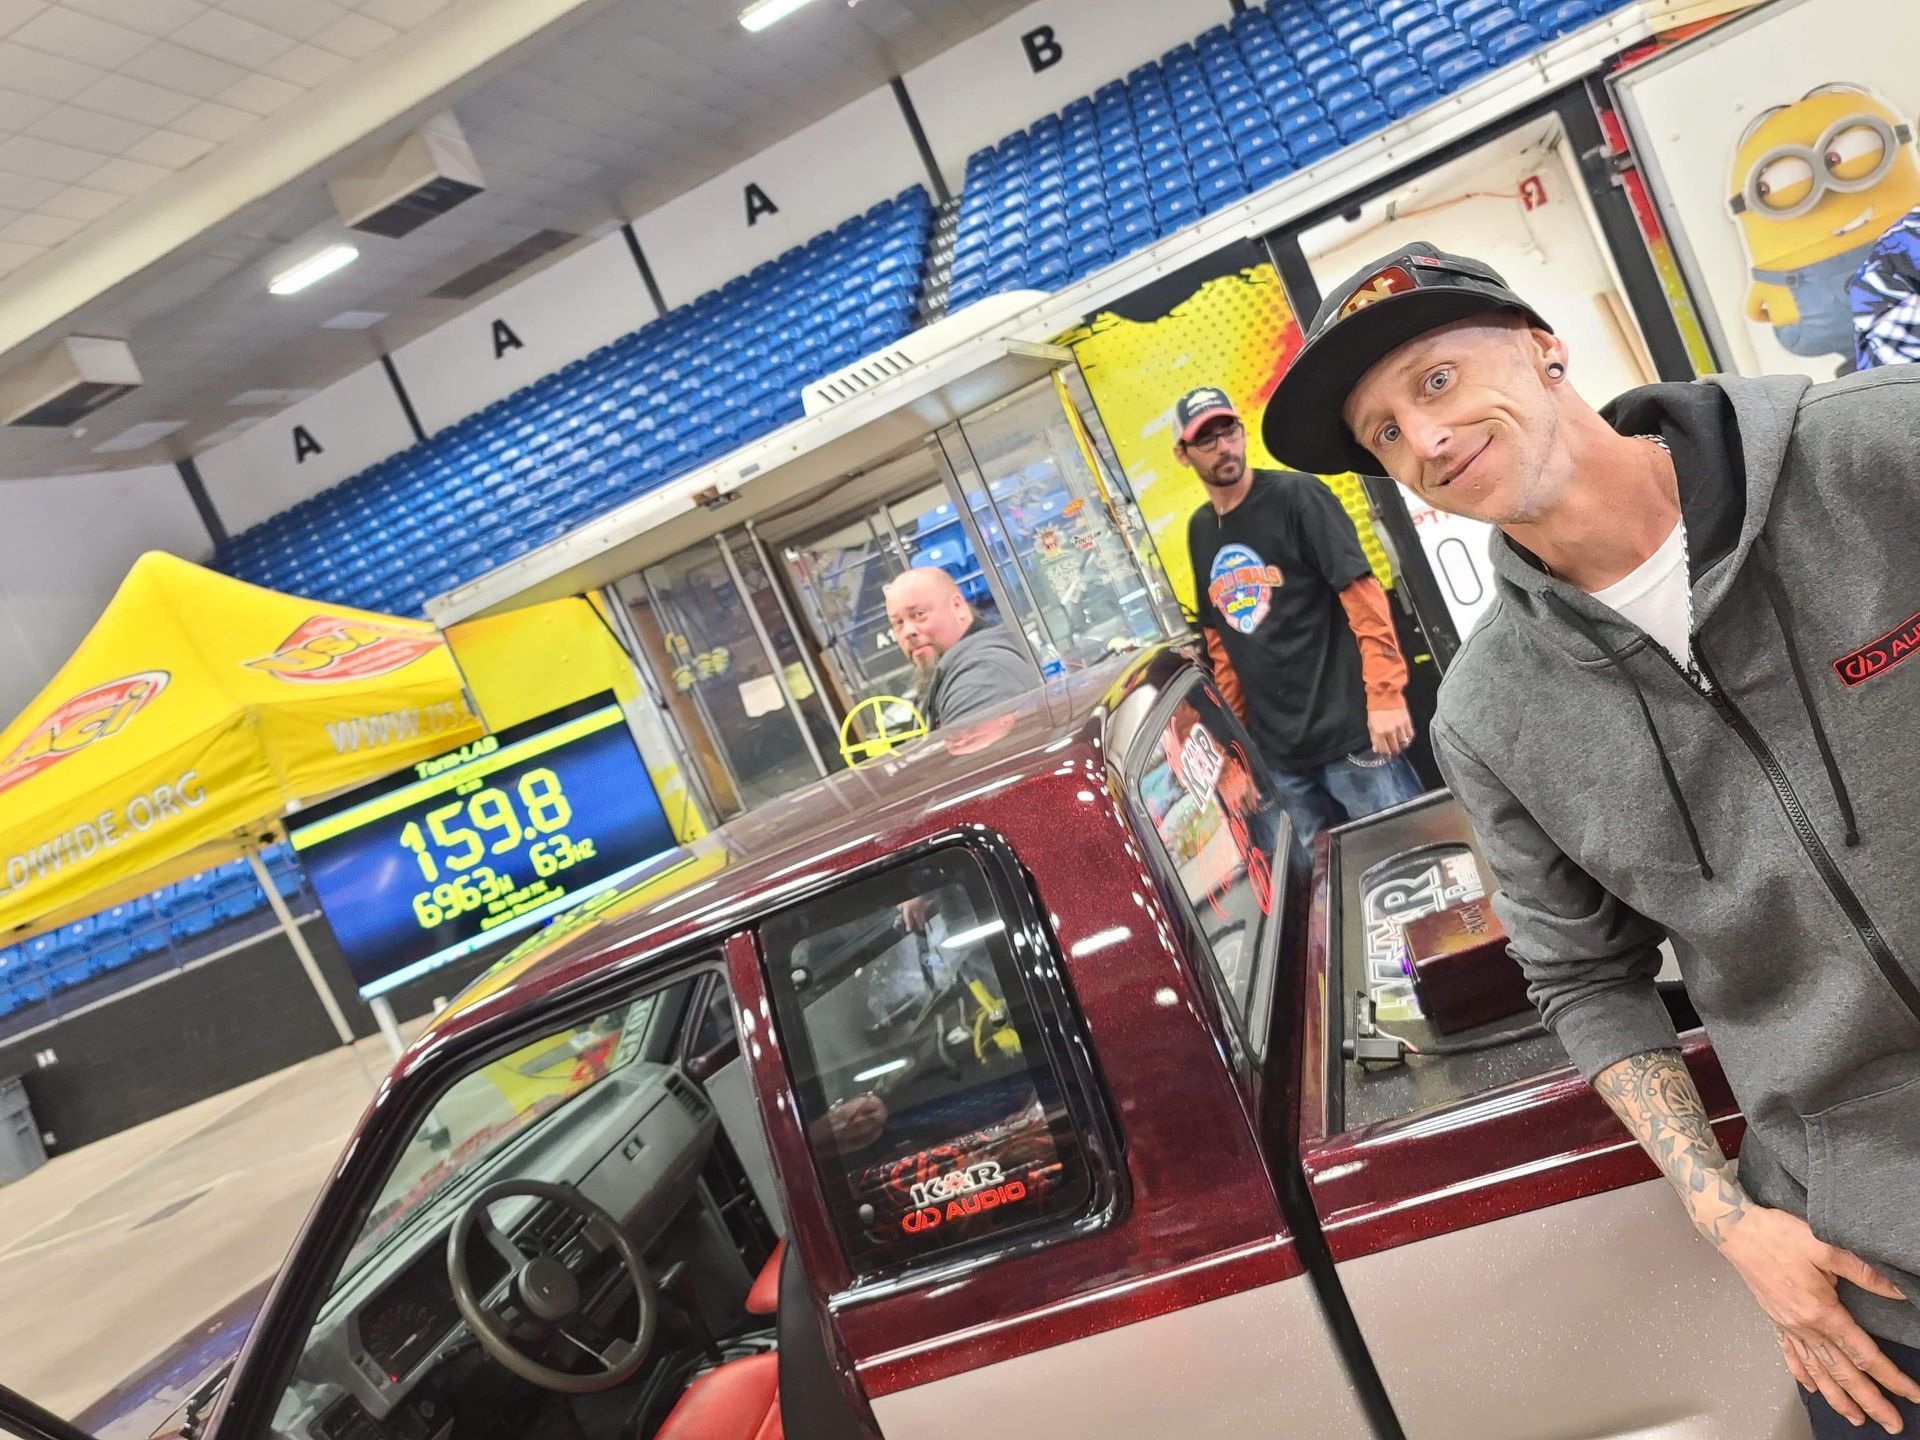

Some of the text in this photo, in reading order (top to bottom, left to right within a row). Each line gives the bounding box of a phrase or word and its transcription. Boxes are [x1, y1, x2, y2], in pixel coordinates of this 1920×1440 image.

[1021, 25, 1063, 73] B
[744, 182, 779, 226] A
[491, 319, 523, 358] A
[292, 425, 323, 463] A
[399, 767, 573, 883] 159.8
[909, 1160, 1006, 1209] KAR
[945, 1179, 1028, 1222] AUDIO
